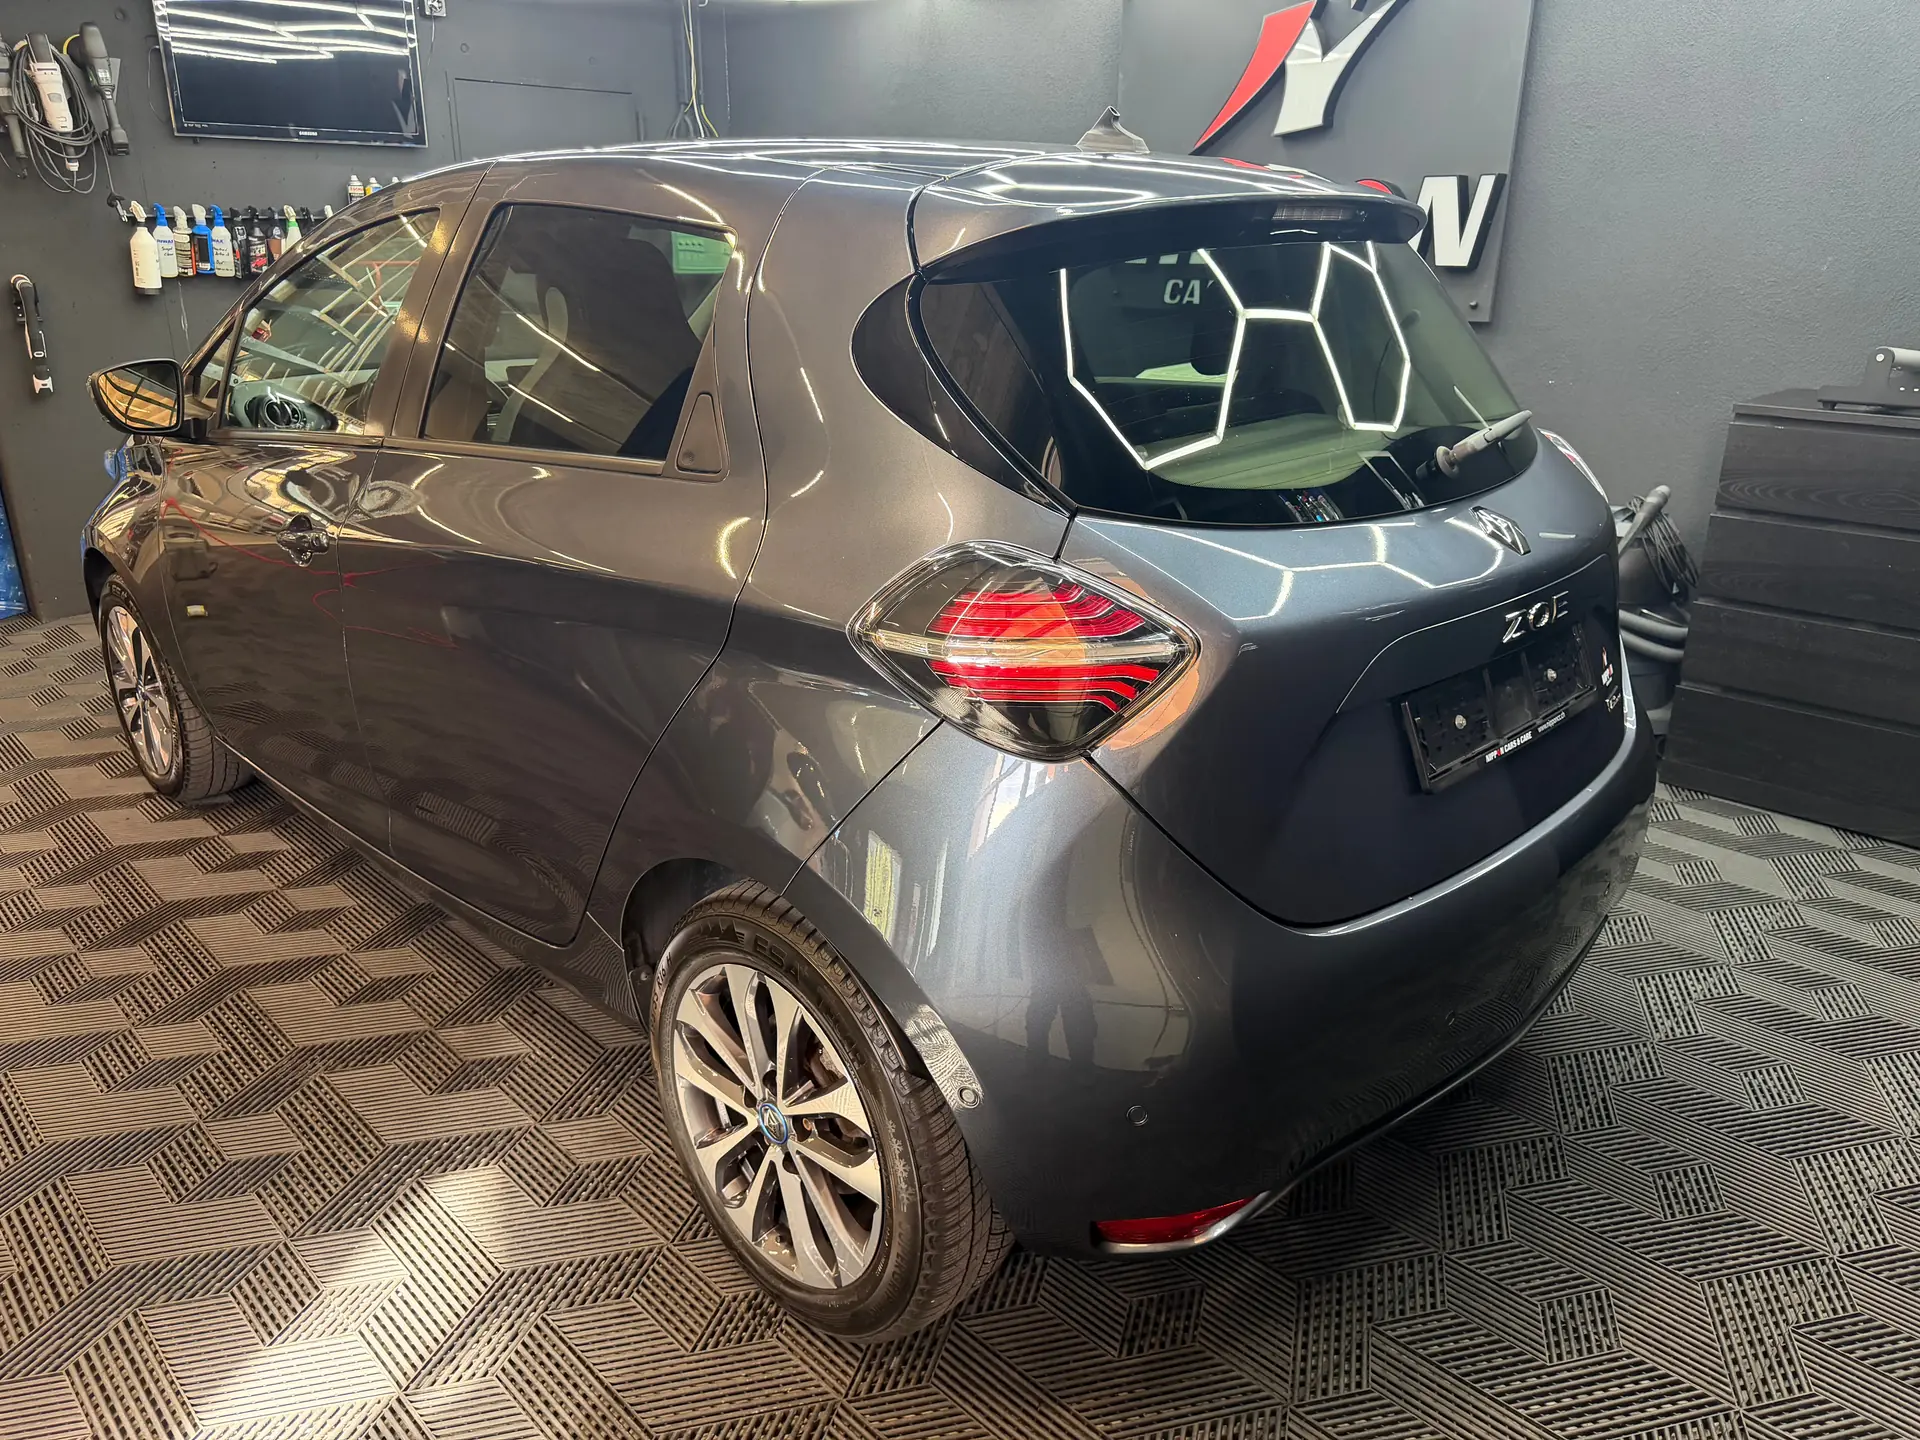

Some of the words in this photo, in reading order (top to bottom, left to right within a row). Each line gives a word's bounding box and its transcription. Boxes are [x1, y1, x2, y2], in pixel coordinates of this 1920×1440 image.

[1502, 590, 1569, 644] ZOE
[1504, 739, 1517, 753] CARS
[1520, 730, 1533, 744] CARE
